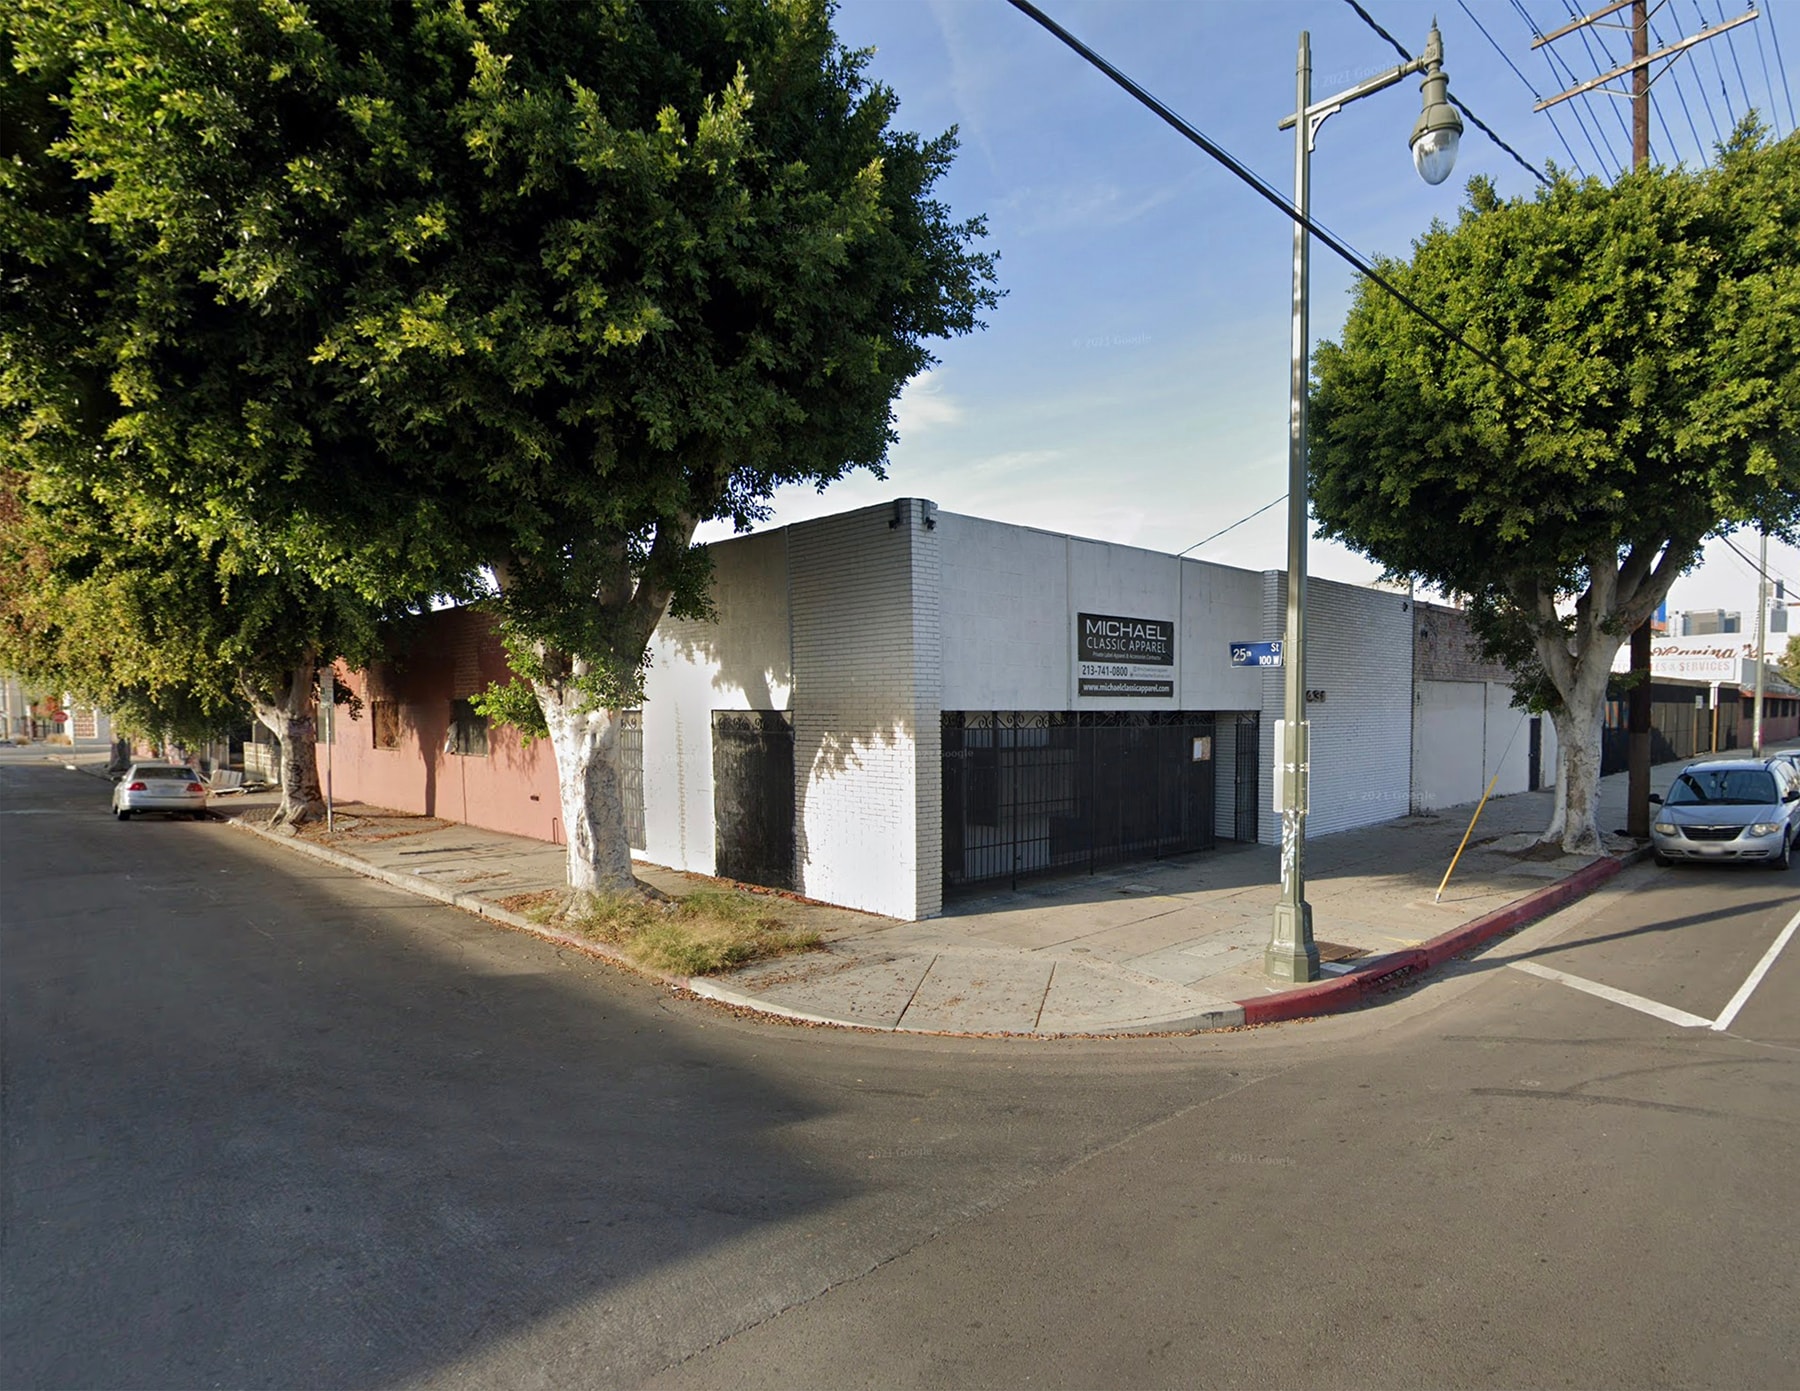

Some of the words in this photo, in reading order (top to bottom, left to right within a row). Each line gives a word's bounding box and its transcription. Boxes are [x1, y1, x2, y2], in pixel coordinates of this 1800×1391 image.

[1086, 619, 1167, 640] MICHAEL
[1086, 637, 1126, 651] CLASSIC
[1128, 639, 1166, 653] APPAREL
[1270, 643, 1280, 652] St
[1259, 655, 1272, 665] 100
[1082, 664, 1129, 677] 213-741-0800
[1679, 661, 1730, 672] SERVICES
[1083, 683, 1170, 694] www.michaelclassicapparel.com
